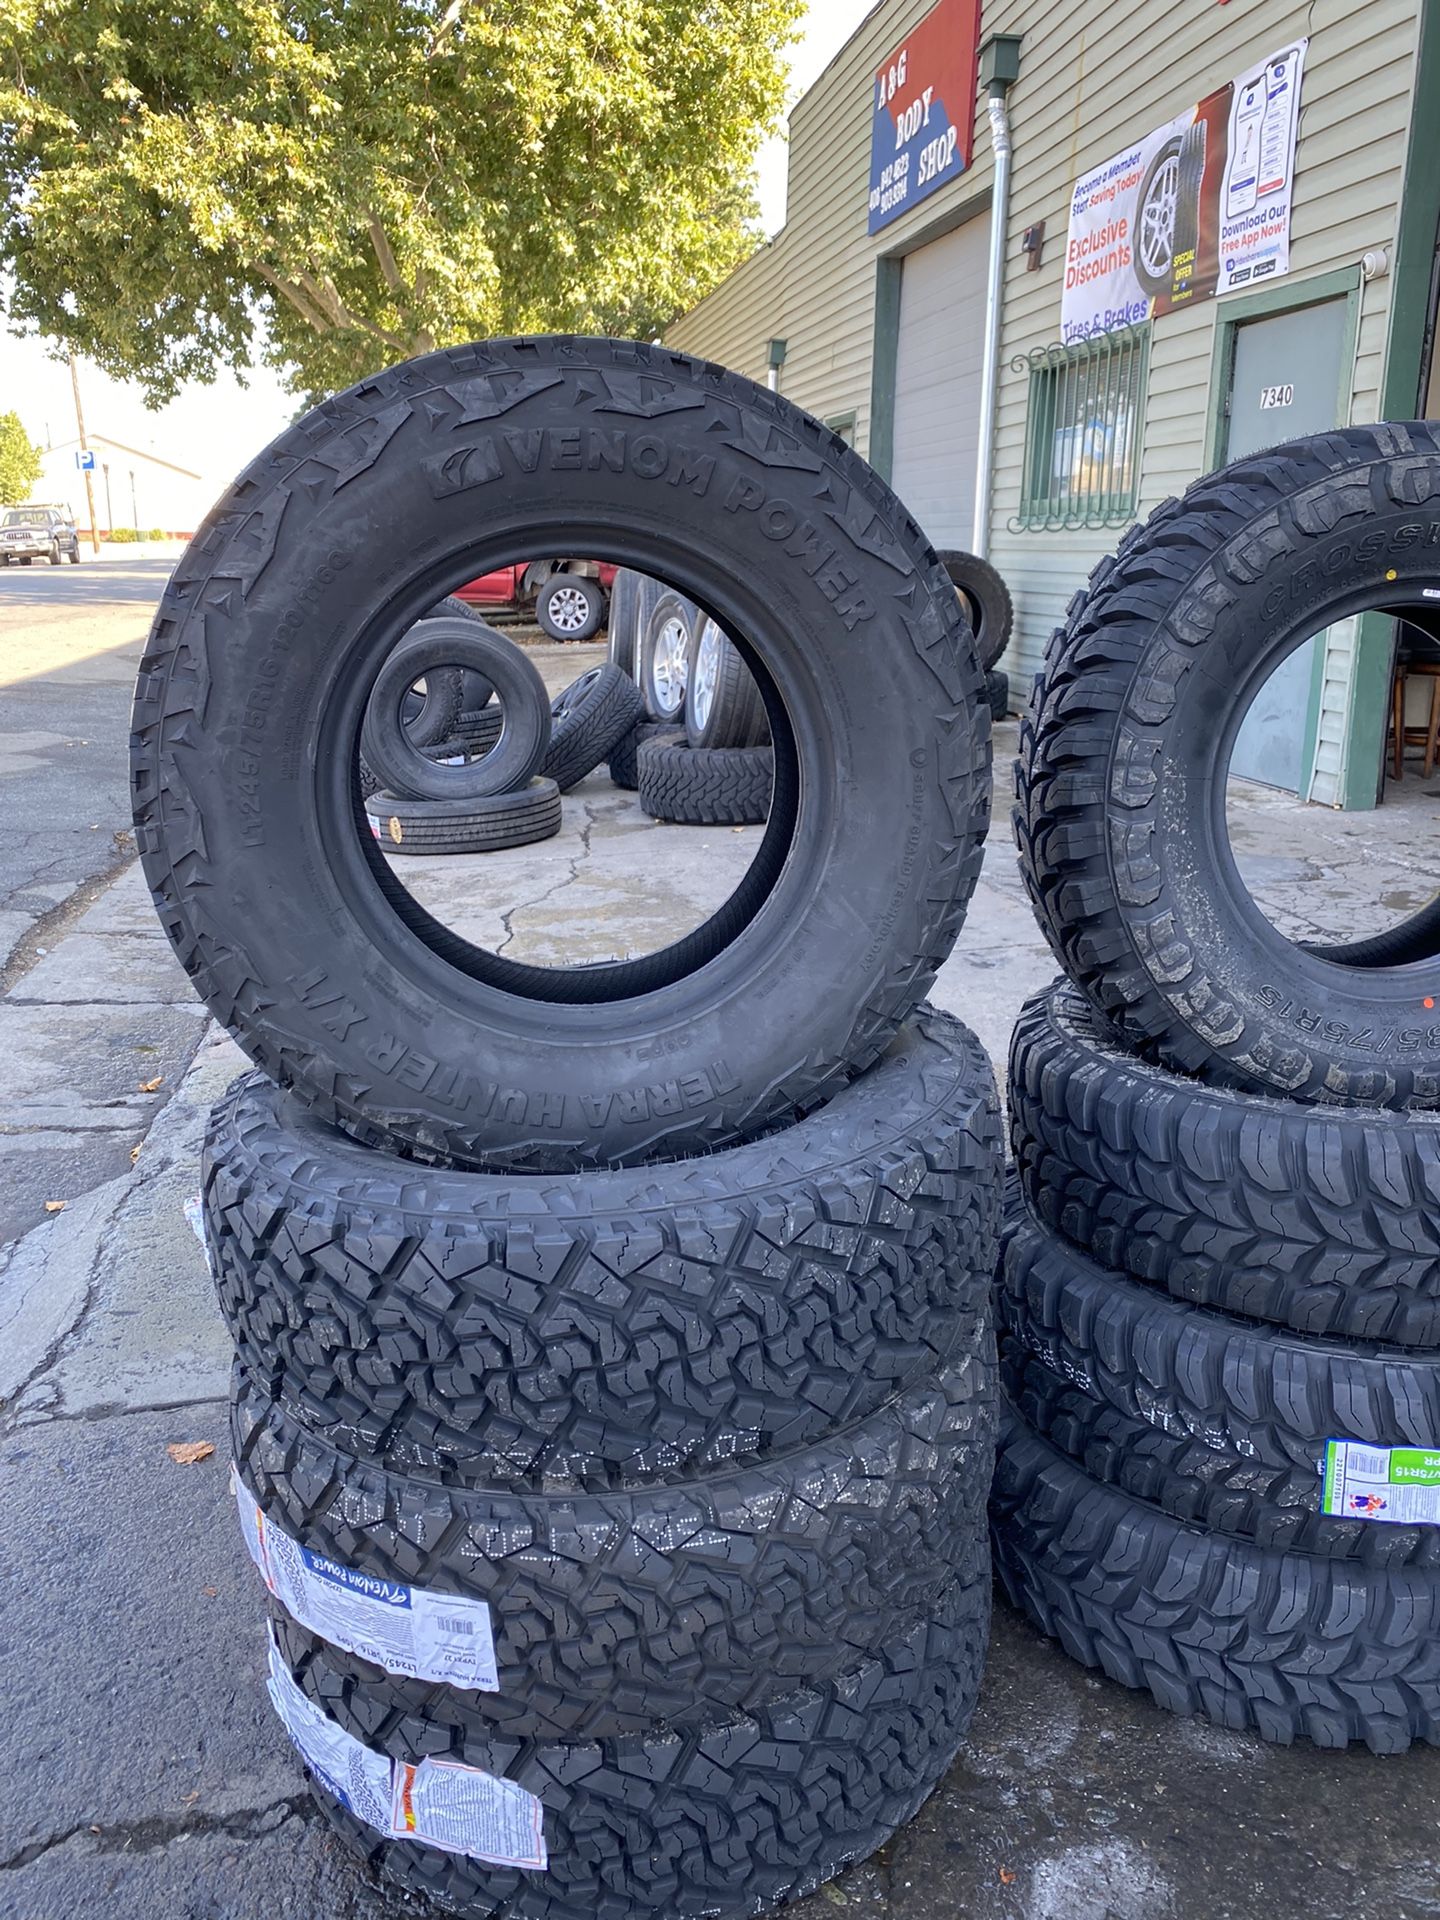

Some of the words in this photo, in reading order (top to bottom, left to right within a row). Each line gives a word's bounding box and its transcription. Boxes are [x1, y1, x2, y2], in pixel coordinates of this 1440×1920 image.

[895, 86, 934, 150] BODY
[918, 125, 957, 187] SHOP
[1074, 175, 1102, 199] Become
[1102, 171, 1108, 183] a
[1108, 151, 1141, 180] Member
[1072, 198, 1089, 217] Start
[1089, 185, 1116, 207] Saving
[1221, 208, 1267, 239] Download
[1268, 204, 1287, 221] Our
[1068, 217, 1128, 262] Exclusive
[1172, 248, 1195, 267] SPECIAL
[1221, 240, 1240, 255] Free
[1241, 231, 1260, 250] App
[1260, 217, 1287, 240] Now!
[1065, 244, 1131, 289] Discounts
[1175, 264, 1193, 281] OFFER
[1063, 319, 1091, 344] Tires
[1092, 313, 1101, 336] &
[1104, 299, 1148, 332] Brakes
[1261, 385, 1293, 408] 7340
[502, 426, 718, 497] VENOM
[723, 471, 878, 632] POWER
[285, 965, 369, 1042] X/T
[364, 1030, 565, 1129] HUNTER
[581, 1058, 743, 1128] TERRA
[311, 1555, 348, 1582] POWER
[348, 1572, 390, 1598] VENOM
